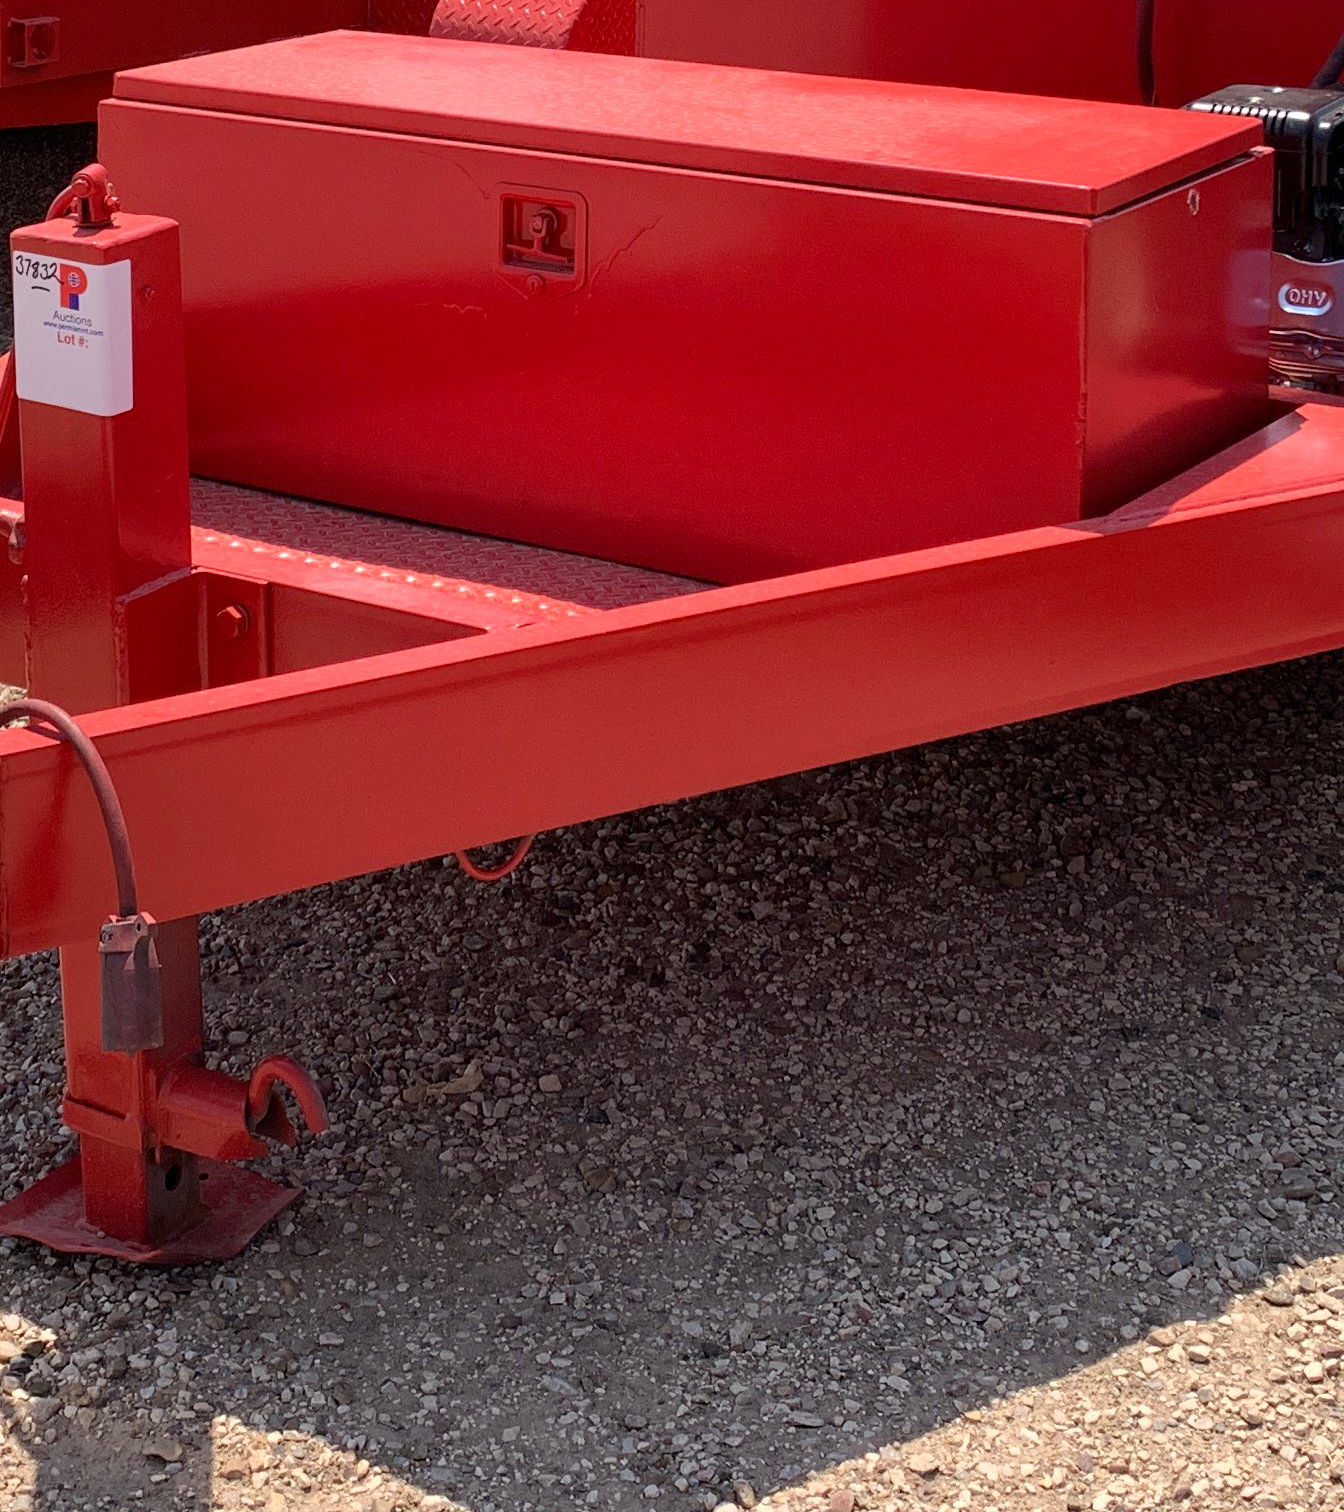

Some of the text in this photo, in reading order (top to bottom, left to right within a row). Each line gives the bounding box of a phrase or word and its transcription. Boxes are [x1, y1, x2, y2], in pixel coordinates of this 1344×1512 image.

[15, 255, 64, 285] 37832
[1289, 288, 1327, 306] OHV
[53, 310, 93, 328] Auctions
[57, 331, 76, 346] Lot
